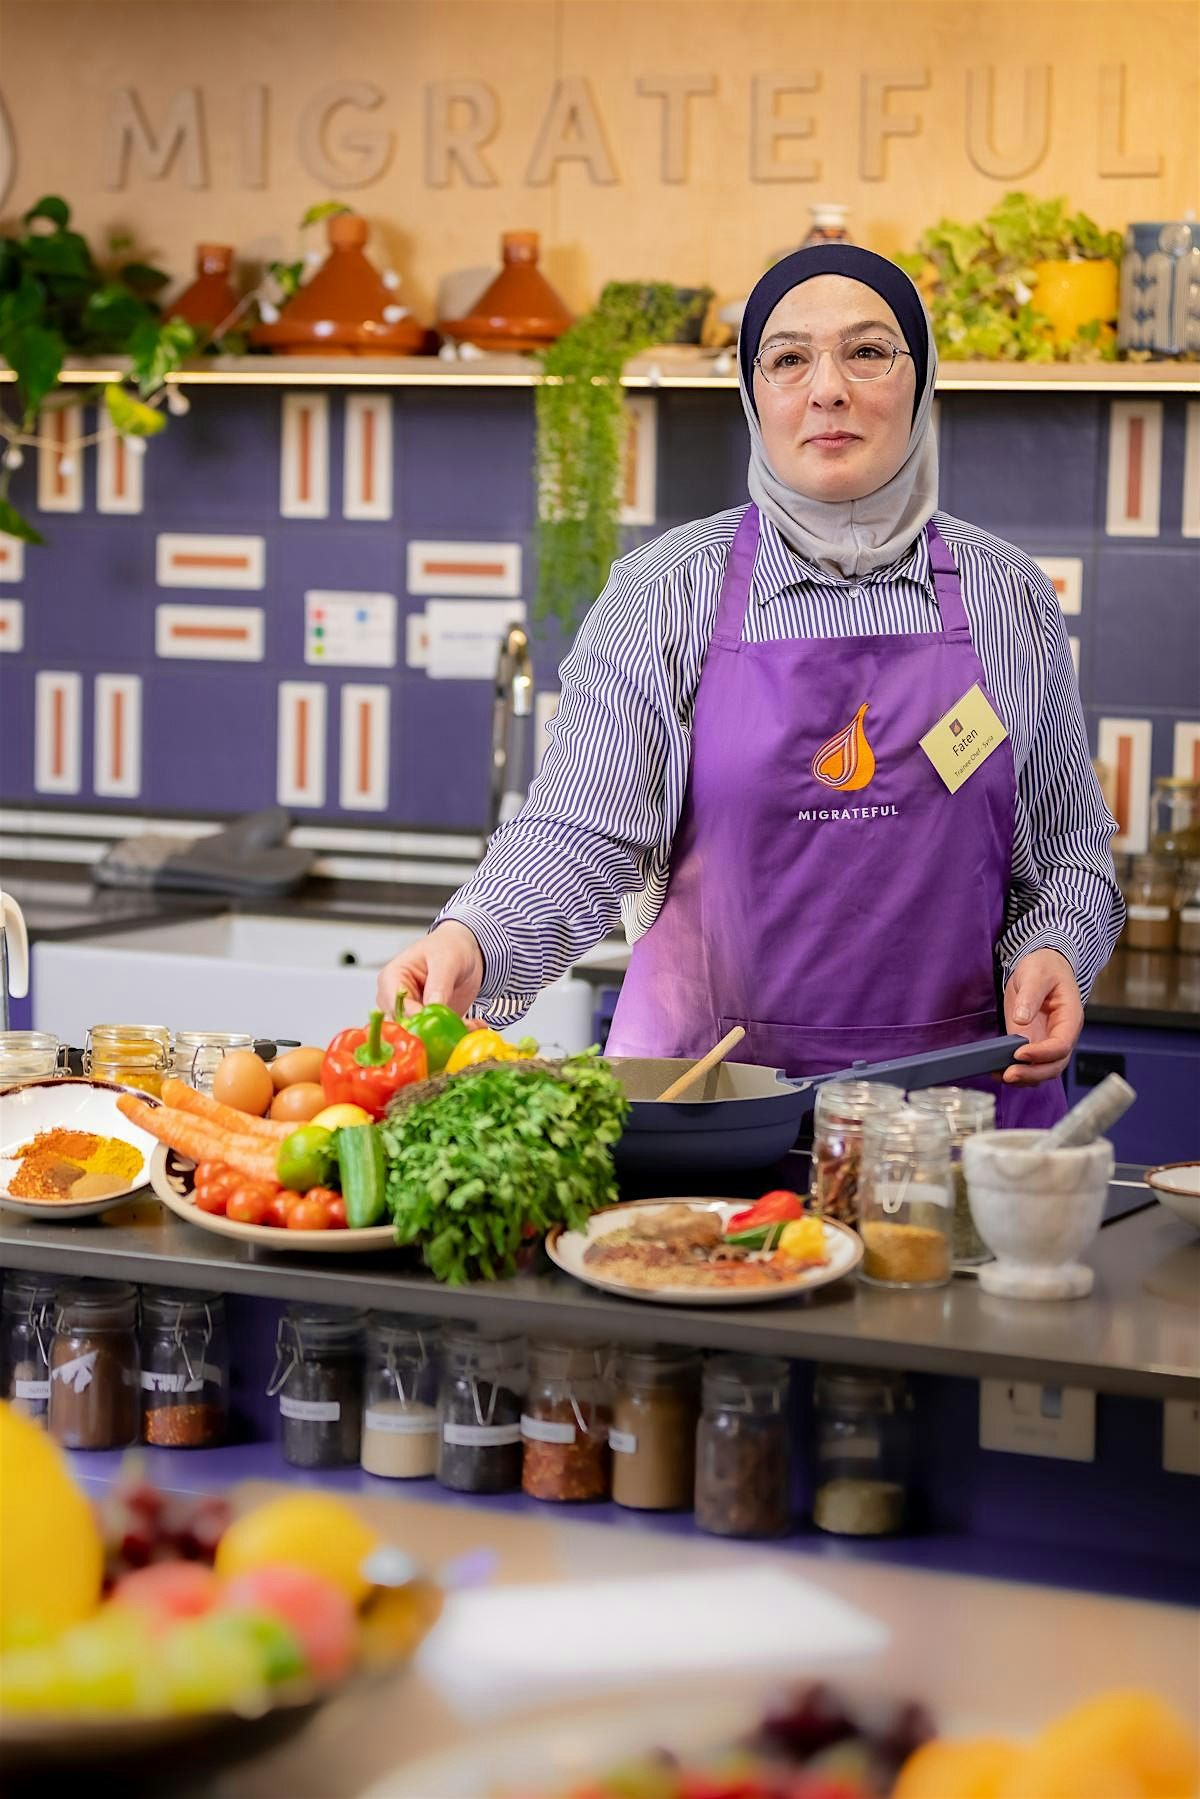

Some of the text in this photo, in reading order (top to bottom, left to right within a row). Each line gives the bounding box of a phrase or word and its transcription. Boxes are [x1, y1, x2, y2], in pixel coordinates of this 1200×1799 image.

[104, 62, 1163, 192] MIGRATEFUL
[952, 729, 978, 757] Faten
[954, 759, 972, 777] Trainee
[970, 748, 981, 761] Chef
[798, 805, 899, 821] MIGRATEFUL
